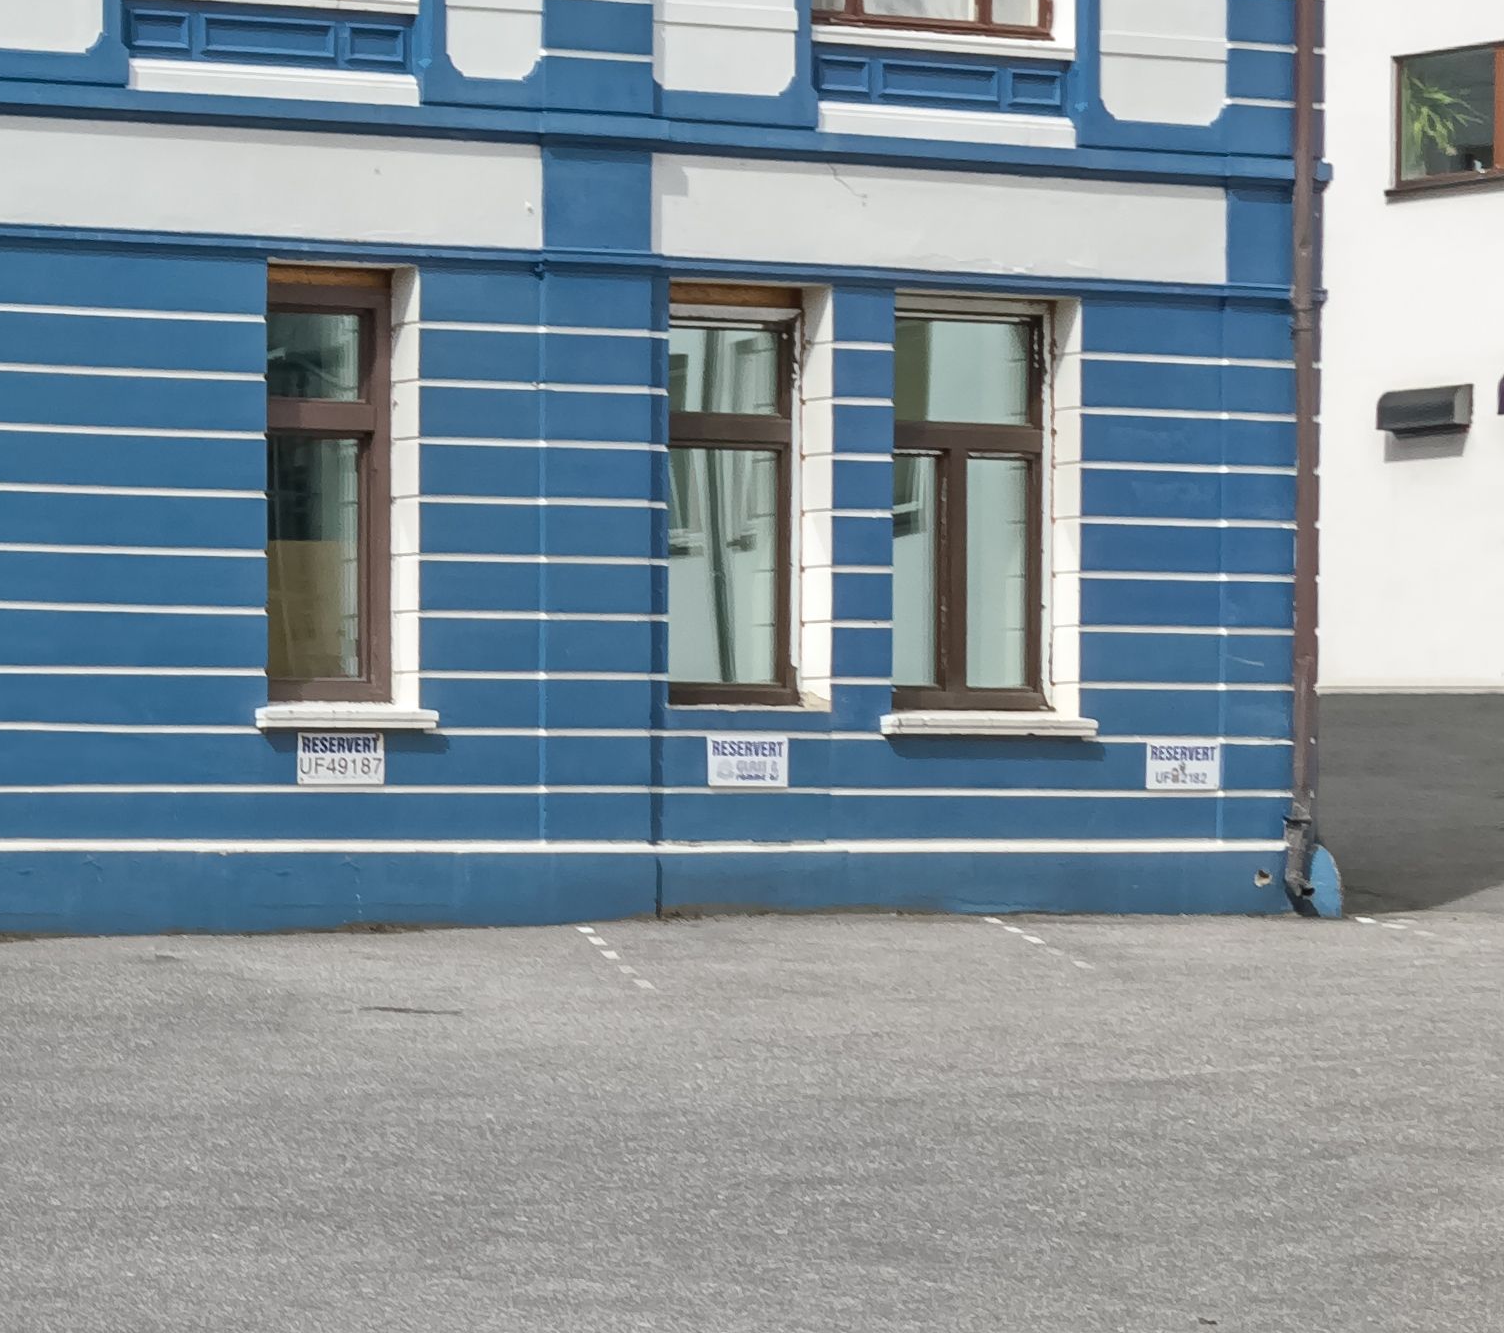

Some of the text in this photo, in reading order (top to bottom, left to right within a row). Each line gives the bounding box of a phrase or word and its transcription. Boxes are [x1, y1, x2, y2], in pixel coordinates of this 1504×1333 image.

[301, 736, 378, 753] RESERVERT
[711, 740, 783, 757] RESERVERT
[1150, 745, 1216, 761] RESERVERT
[299, 757, 382, 775] UF49187
